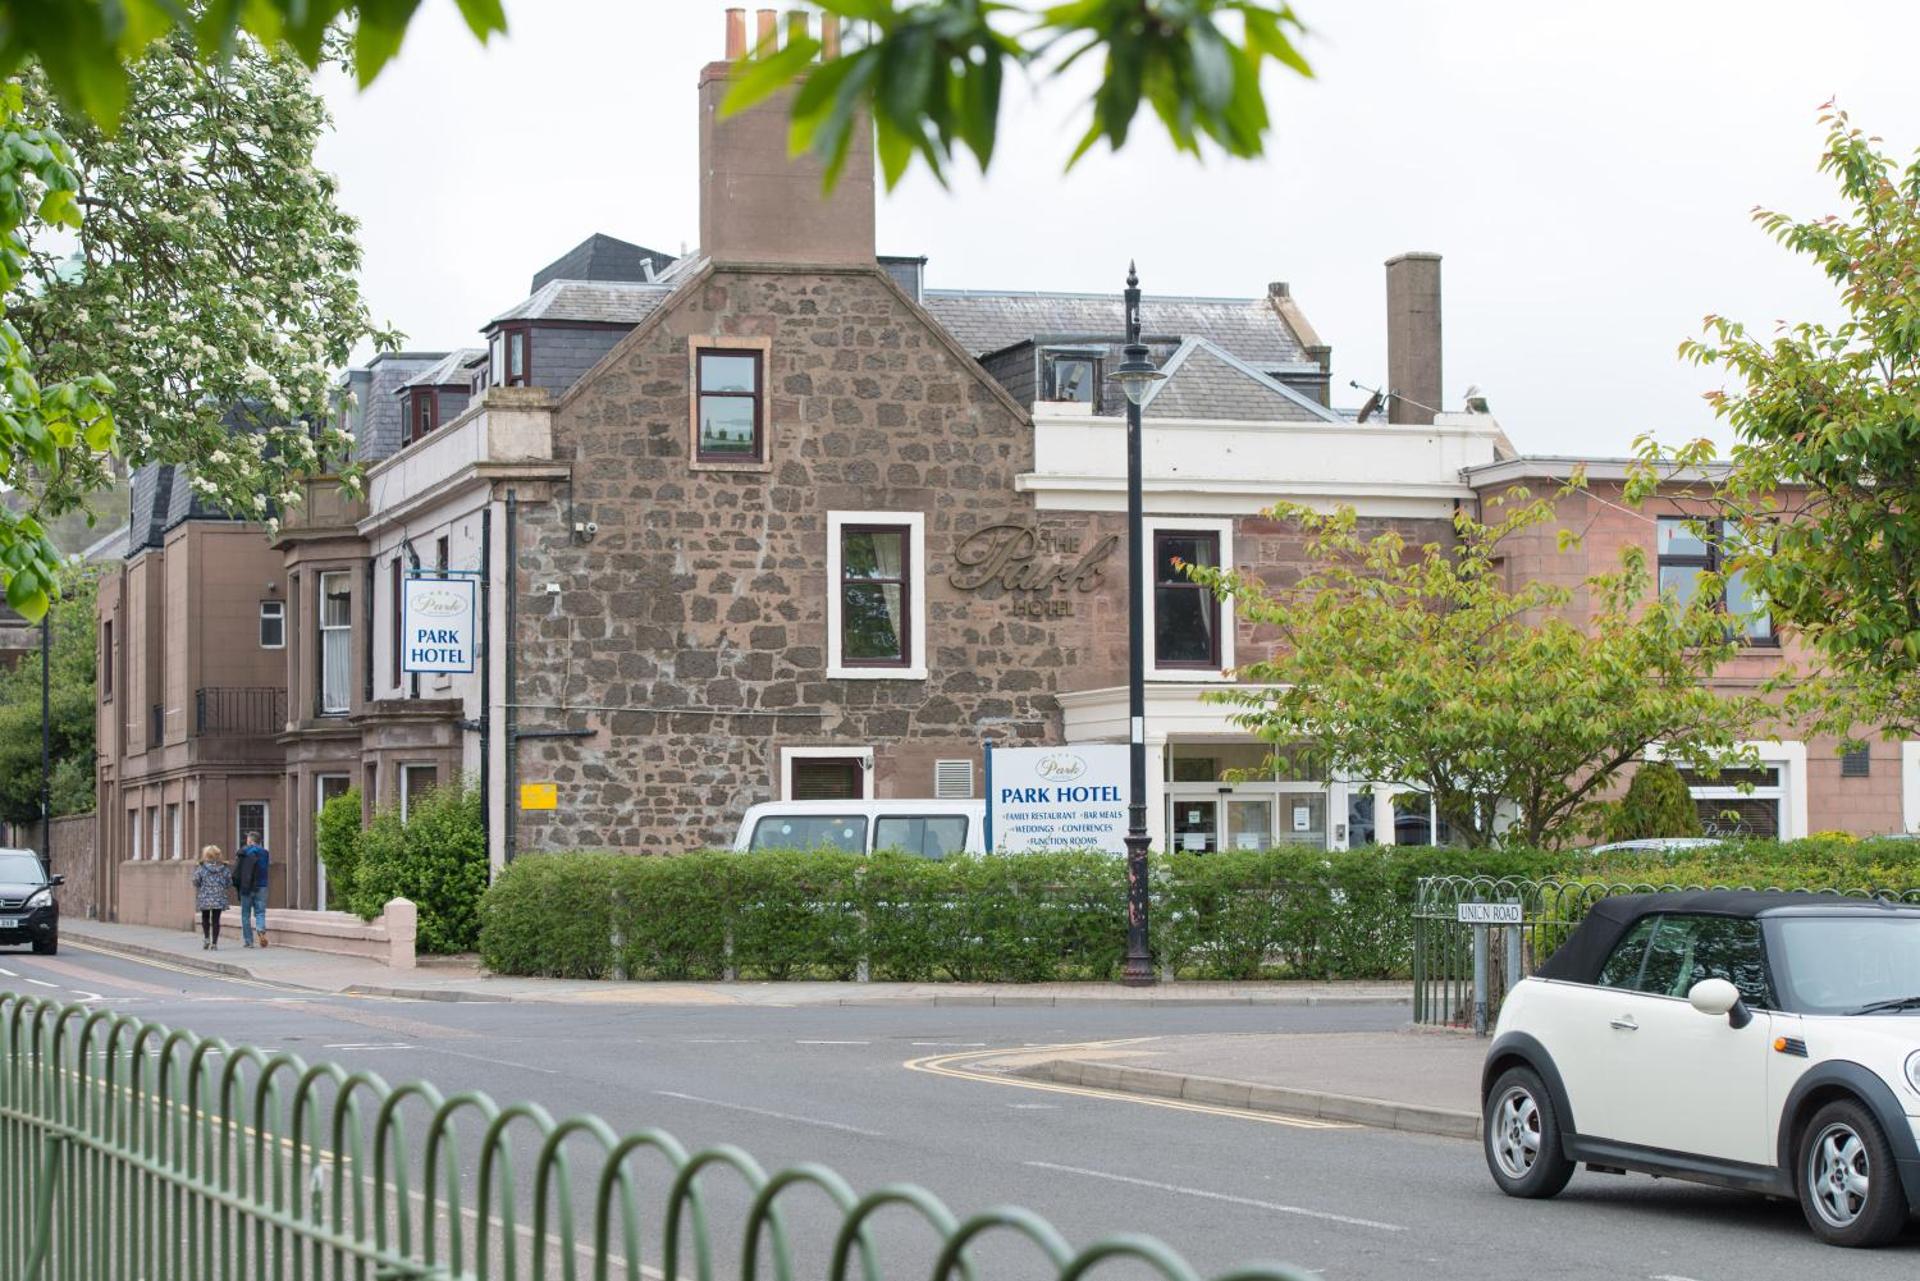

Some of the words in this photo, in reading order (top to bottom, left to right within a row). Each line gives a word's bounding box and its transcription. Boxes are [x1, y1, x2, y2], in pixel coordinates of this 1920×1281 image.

[949, 525, 1119, 593] Park
[414, 598, 460, 612] Park
[1012, 600, 1075, 617] HOTEL
[417, 629, 460, 644] PARK
[411, 648, 466, 663] HOTEL
[1041, 760, 1080, 776] Park
[1001, 787, 1050, 803] PARK
[1057, 786, 1122, 802] HOTEL
[1006, 812, 1029, 821] FAMILY
[1031, 811, 1076, 820] RESTAURANT
[1083, 811, 1098, 819] BAR
[1100, 810, 1123, 819] MEALS
[1015, 824, 1055, 833] WEDDINGS
[1061, 824, 1113, 832] CONFERENCES
[1030, 837, 1068, 845] FUNCTION
[1069, 837, 1098, 845] ROOMS
[1461, 906, 1490, 920] UNION
[1493, 906, 1519, 920] ROAD
